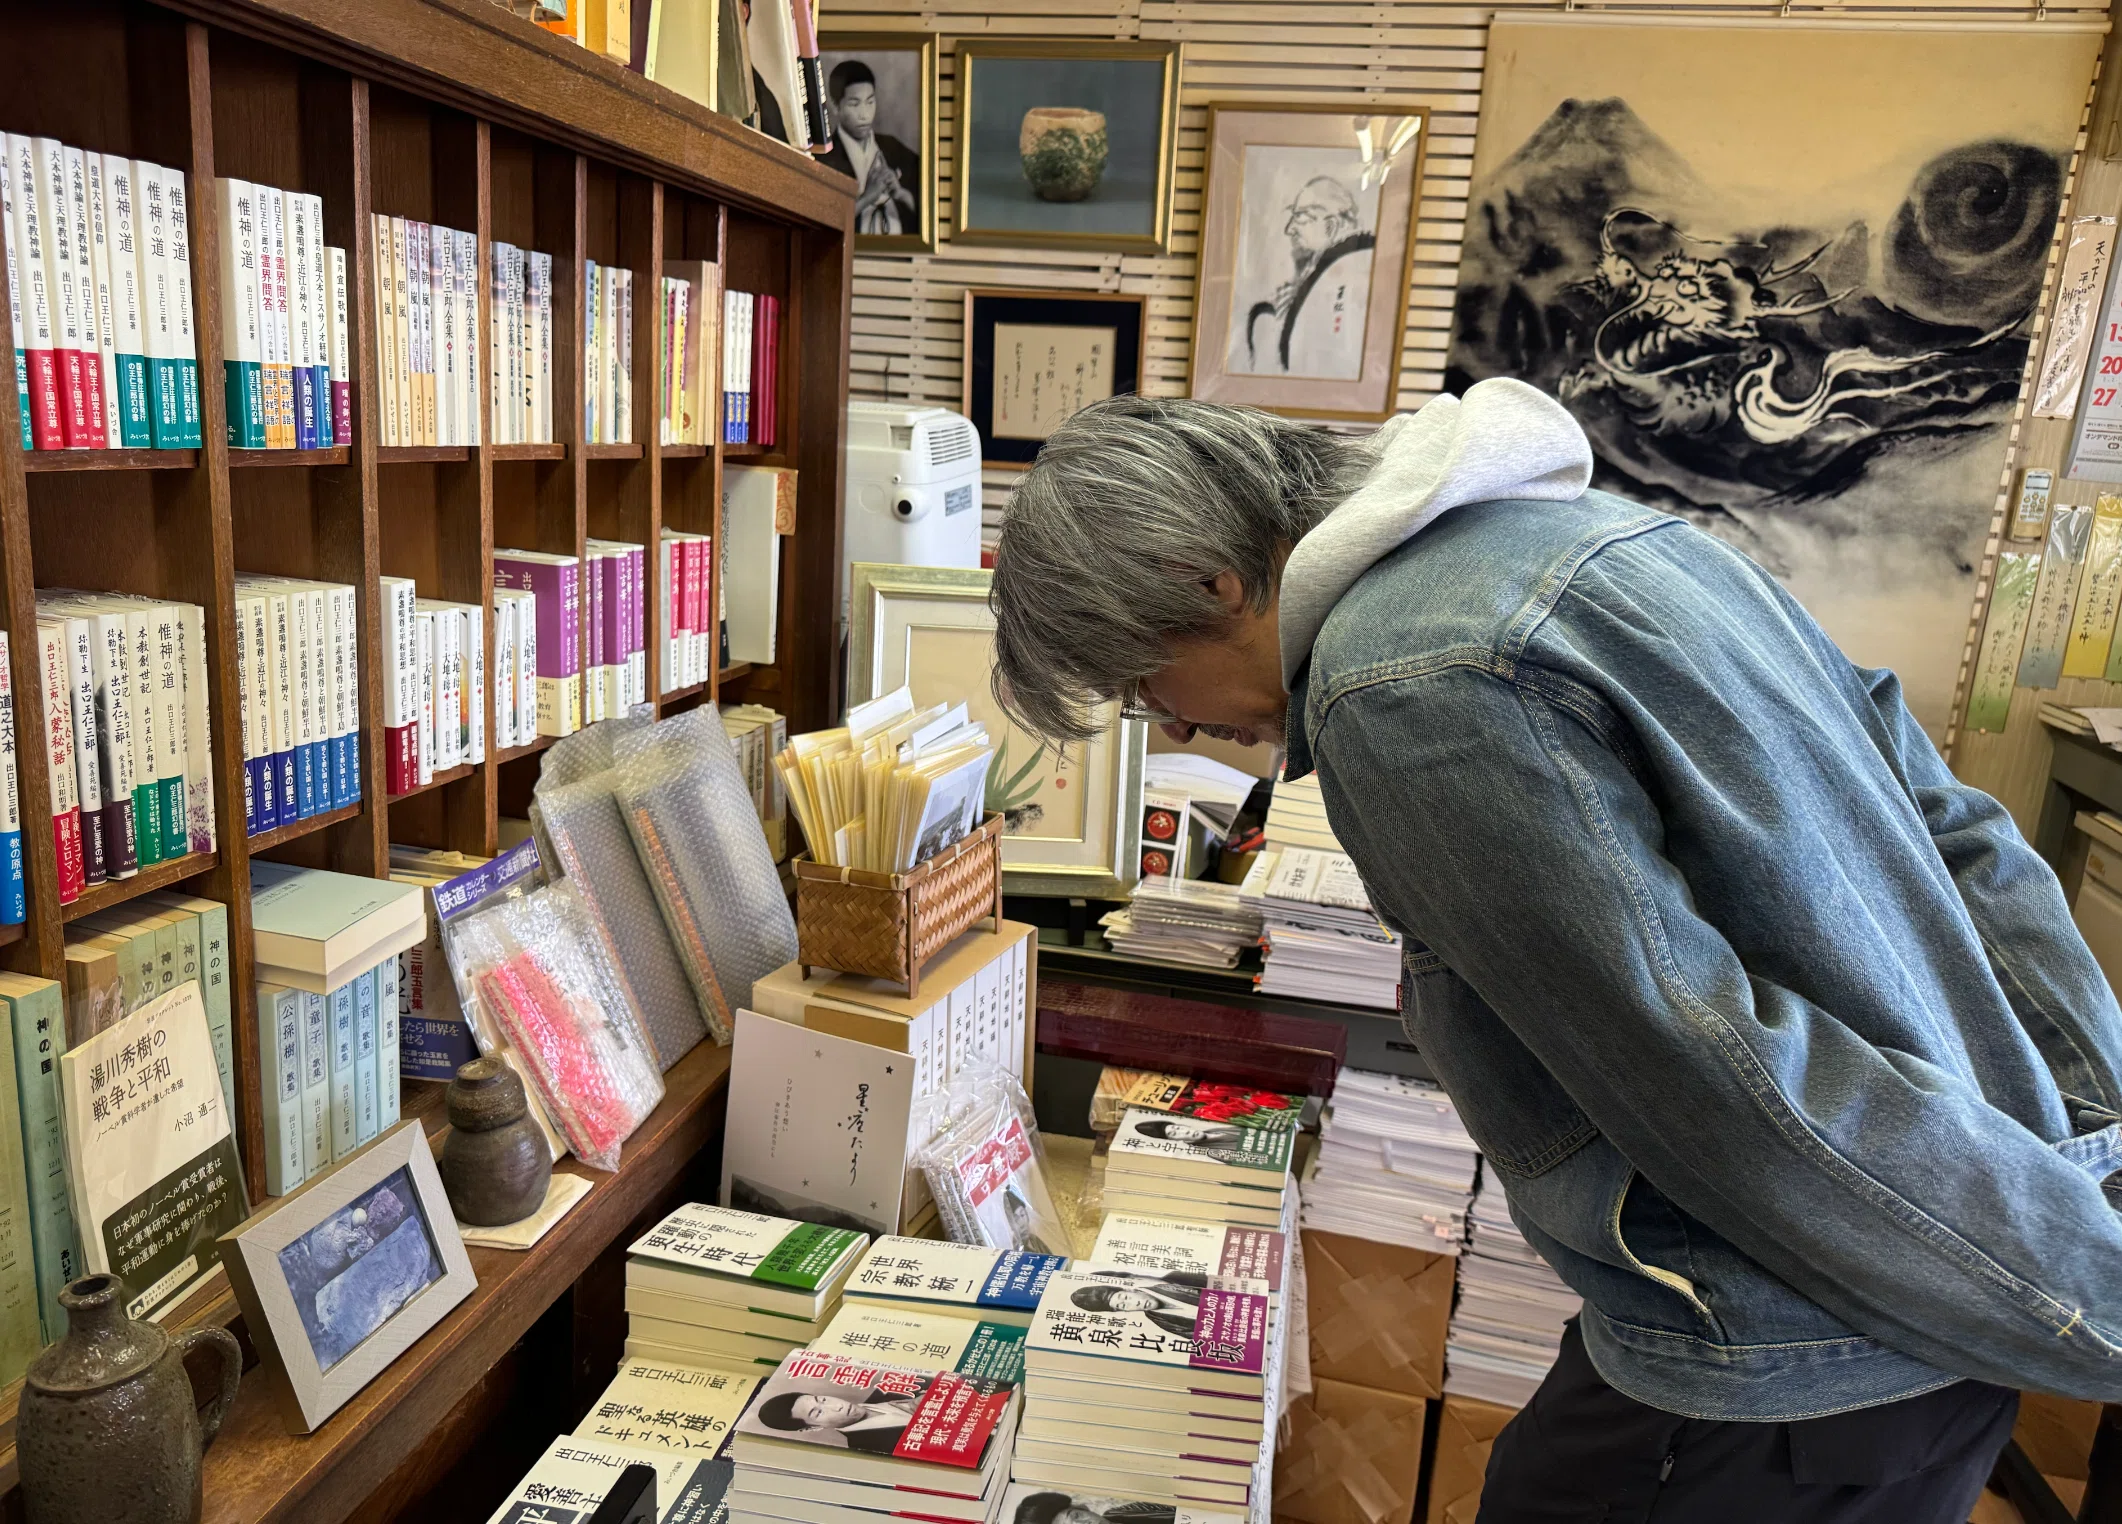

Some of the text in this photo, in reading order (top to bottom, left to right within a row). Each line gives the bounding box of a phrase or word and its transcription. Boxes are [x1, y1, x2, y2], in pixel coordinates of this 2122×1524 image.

[20, 147, 40, 259] 大本神諭と天理教神諭
[51, 151, 69, 260] 大本神諭と天理教神諭
[72, 158, 89, 265] 大本神諭と天理教神諭
[90, 165, 104, 244] 皇道大本の信仰
[114, 175, 134, 253] 惟神の道
[147, 181, 165, 257] 惟神の道
[169, 186, 187, 262] 惟神の道
[238, 197, 254, 269] 惟神の道
[260, 193, 272, 311] 出口王仁三郎の霊界問答
[274, 196, 287, 313] 出口王仁三郎の霊界問答
[8, 248, 21, 323] 出口王仁三郎著
[33, 270, 49, 339] 出口王仁三郎
[62, 271, 77, 338] 出口王仁三郎
[82, 276, 95, 342] 出口王仁三郎
[126, 271, 136, 330] 出口王仁三郎著
[158, 274, 167, 332] 出口王仁三郎著
[180, 278, 188, 334] 出口王仁三郎著
[443, 231, 454, 338] 出口王仁三郎全集
[464, 236, 476, 341] 出口王仁三郎全集
[506, 248, 516, 346] 出口王仁三郎全集
[515, 252, 523, 347] 出口王仁三郎全集
[540, 256, 549, 350] 出口王仁三郎全集
[99, 284, 112, 347] 出口王仁三郎
[247, 285, 255, 340] 出口王仁三郎著
[2100, 356, 2122, 375] 20
[303, 374, 313, 428] 人類の誕生
[2092, 388, 2117, 407] 27
[298, 598, 307, 648] 出口王仁三郎
[316, 598, 324, 646] 出口王仁三郎
[334, 595, 342, 642] 出口王仁三郎
[47, 643, 59, 701] 出口王仁三郎
[78, 634, 88, 674] 弥勒下生
[108, 629, 117, 668] 弥勒下生
[137, 626, 151, 694] 本教創世記
[158, 623, 175, 690] 惟神の道
[0, 694, 15, 754] 道之大本
[49, 702, 65, 765] 入蒙秘話
[81, 682, 96, 750] 出口王仁三郎
[111, 676, 125, 744] 出口王仁三郎
[167, 704, 176, 755] 出口王仁三郎著
[261, 715, 269, 753] 出口王仁三郎
[6, 764, 18, 824] 出口王仁三郎著
[245, 767, 254, 817] 人類の誕生
[264, 762, 273, 811] 人類の誕生
[285, 757, 294, 806] 人類の誕生
[10, 838, 22, 880] 教の原点
[60, 819, 75, 882] 冒険とロマン
[438, 884, 467, 913] 鉄道
[466, 874, 490, 892] カレンダー
[466, 884, 487, 900] シリーズ
[161, 951, 173, 983] 神の
[184, 944, 196, 981] 神の
[209, 940, 222, 986] 神の国
[36, 1018, 52, 1075] 神の国
[281, 1004, 295, 1059] 公孫樹
[341, 1043, 349, 1062] 歌集
[362, 1032, 371, 1050] 歌集
[387, 1020, 394, 1040] 歌集
[90, 1029, 167, 1094] 湯川秀樹の
[286, 1071, 295, 1092] 歌集
[312, 1058, 321, 1078] 歌集
[92, 1056, 171, 1123] 戦争と平和
[174, 1099, 217, 1132] 小沼 通二
[782, 1078, 792, 1131] ひびきあう想い
[289, 1115, 297, 1167] 出口王仁三郎著
[314, 1097, 322, 1150] 出口王仁三郎著
[113, 1157, 222, 1240] 日本初のノーベル賞受賞者は
[117, 1177, 229, 1256] なぜ軍事研究に関わり、戦後、
[692, 1204, 771, 1223] 出口王仁三郎
[121, 1193, 227, 1276] 平和運動に身を捧げたのか？
[642, 1234, 765, 1267] 更生時代
[1107, 1240, 1194, 1258] 善言美詞
[859, 1269, 975, 1294] 宗教統一
[870, 1255, 924, 1272] 世界
[1060, 1274, 1135, 1287] 出口王仁三郎
[1113, 1253, 1208, 1274] 祝詞解説
[839, 1331, 950, 1359] 惟神の道
[1045, 1309, 1143, 1328] 瑞能神歌と
[1049, 1324, 1246, 1363] 黄泉比良坂
[629, 1367, 727, 1390] 出口王仁三郎
[785, 1357, 926, 1399] 言霊解
[799, 1350, 852, 1364] 古事記
[595, 1424, 713, 1449] ドキュメント
[597, 1402, 726, 1432] 聖なる英雄の
